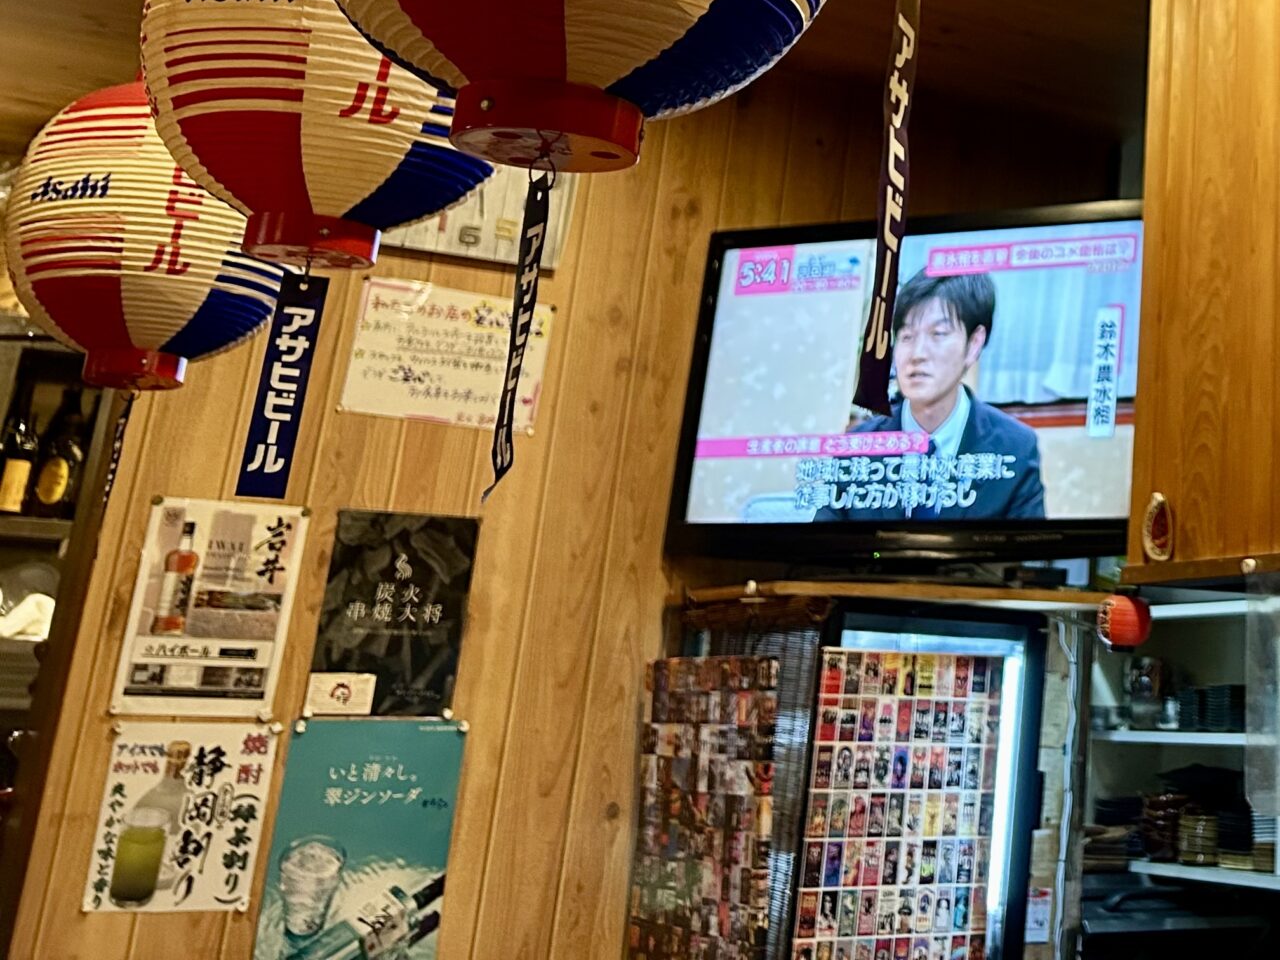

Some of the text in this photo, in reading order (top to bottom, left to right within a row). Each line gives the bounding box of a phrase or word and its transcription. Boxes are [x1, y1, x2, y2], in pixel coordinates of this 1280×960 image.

[31, 172, 112, 201] Asahi
[866, 12, 915, 360] アサヒビール
[459, 225, 482, 247] 6
[739, 257, 793, 287] 5:41
[246, 306, 317, 474] アサヒビール
[255, 516, 293, 585] 岩井
[376, 581, 424, 603] 炭火
[236, 732, 271, 785] 焼酎
